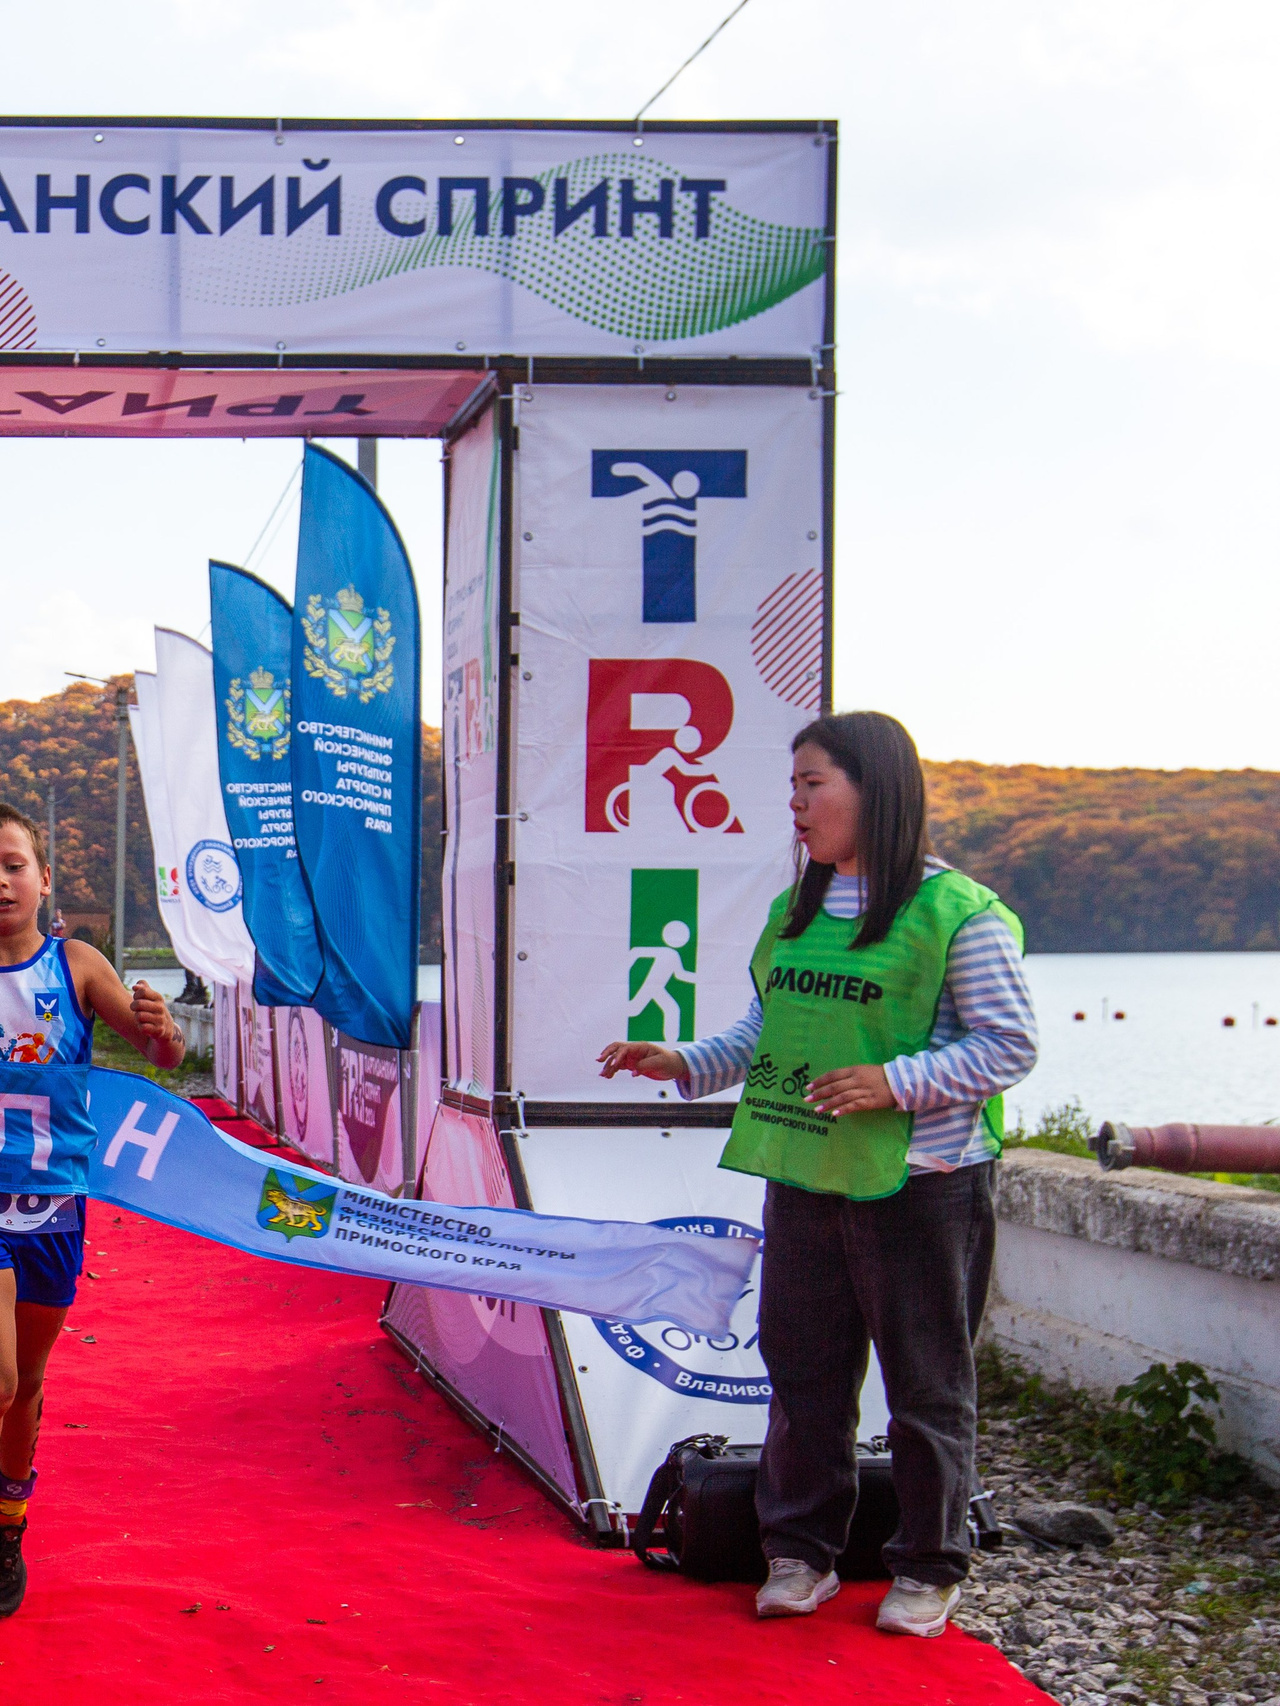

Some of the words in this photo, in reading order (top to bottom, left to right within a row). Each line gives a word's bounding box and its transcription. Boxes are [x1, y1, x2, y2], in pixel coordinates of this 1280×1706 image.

[375, 175, 727, 239] СПРИНТ
[745, 1097, 794, 1114] ФЕДЕРАЦИЯ
[808, 1123, 829, 1137] КРАЯ
[337, 1213, 353, 1224] И
[355, 1218, 430, 1243] СПОРТА
[340, 1205, 469, 1243] ФИЗИЧЕСКОЙ
[473, 1239, 576, 1260] КУЛЬТУРЫ
[343, 1190, 491, 1238] МИНИСТЕРСТВО
[335, 1227, 467, 1264] ПРИМОСКОГО
[472, 1256, 523, 1271] КРАЯ
[675, 1371, 773, 1397] Владиво
